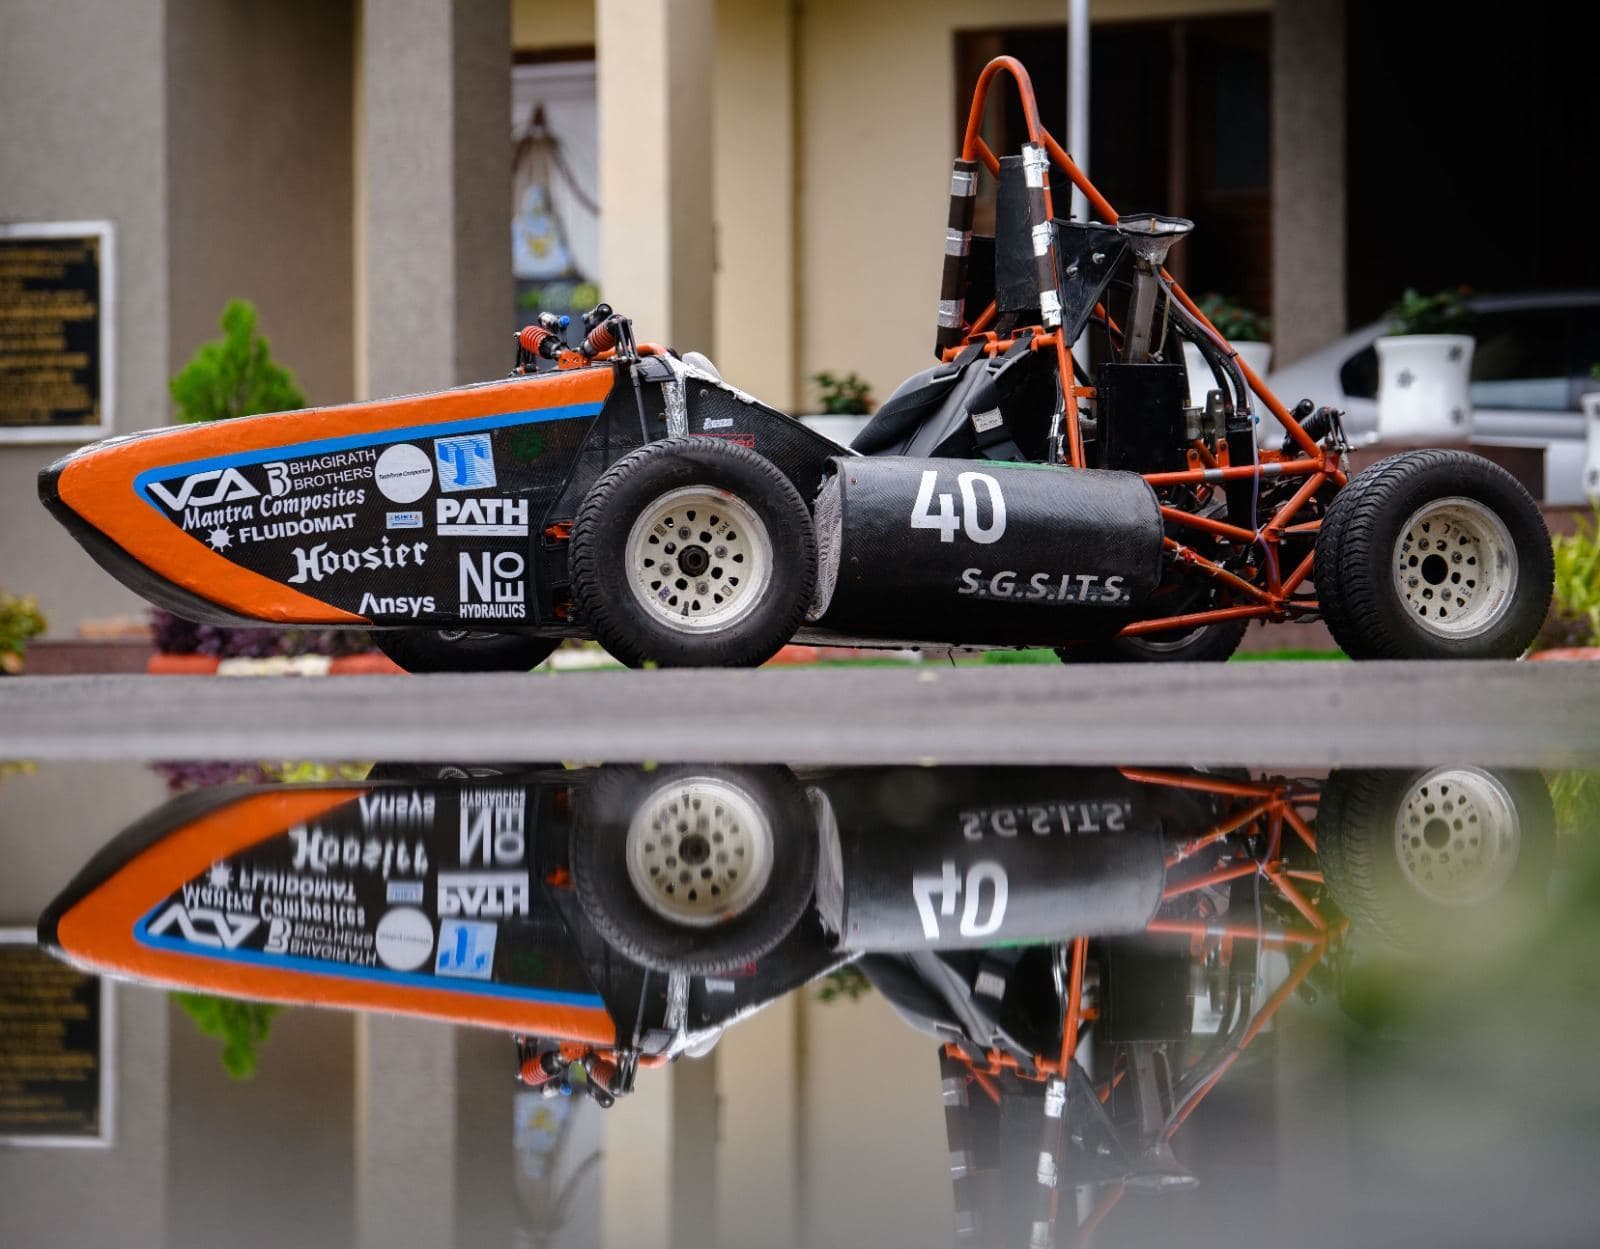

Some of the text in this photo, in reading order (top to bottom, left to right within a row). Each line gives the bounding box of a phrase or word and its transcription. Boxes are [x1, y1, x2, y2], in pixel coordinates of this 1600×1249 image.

[290, 449, 376, 475] BHAGIRATH
[147, 467, 261, 511] VCA
[294, 466, 373, 490] BROTHERS
[182, 487, 366, 531] Mantra Composites
[436, 498, 529, 525] PATH
[911, 470, 1006, 544] 40
[239, 513, 356, 544] FLUIDOMAT
[287, 535, 428, 584] Hoosier
[958, 567, 1131, 602] S.G.S.I.T.S.
[358, 592, 436, 617] Ansys
[459, 603, 526, 618] HYDRAULICS
